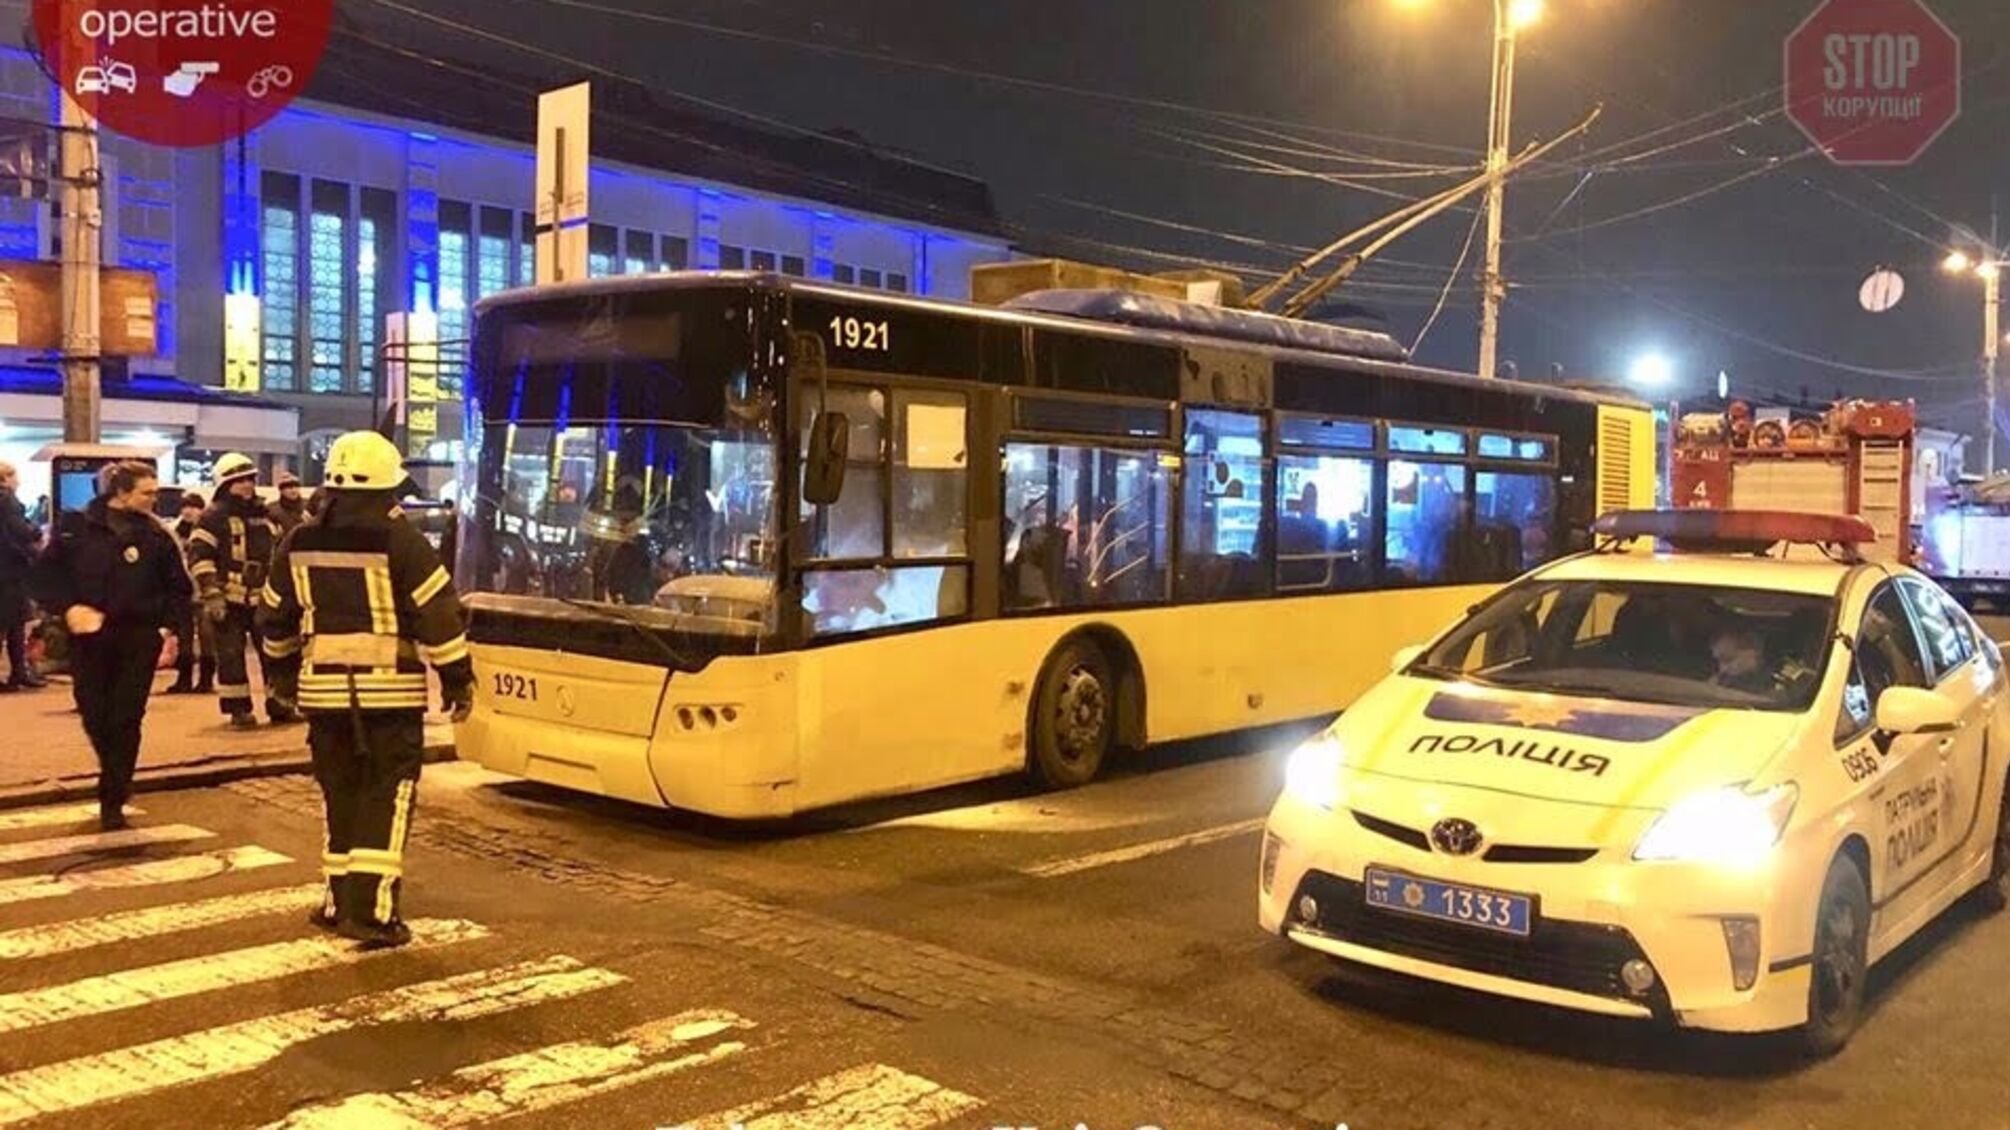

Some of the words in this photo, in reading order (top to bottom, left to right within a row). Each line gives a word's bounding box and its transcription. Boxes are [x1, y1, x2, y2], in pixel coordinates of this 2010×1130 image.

[830, 316, 889, 352] 1921
[1693, 480, 1707, 497] 4
[493, 672, 538, 702] 1921
[1408, 735, 1611, 777] ПОЛІЦІЯ
[1442, 888, 1511, 926] 1333
